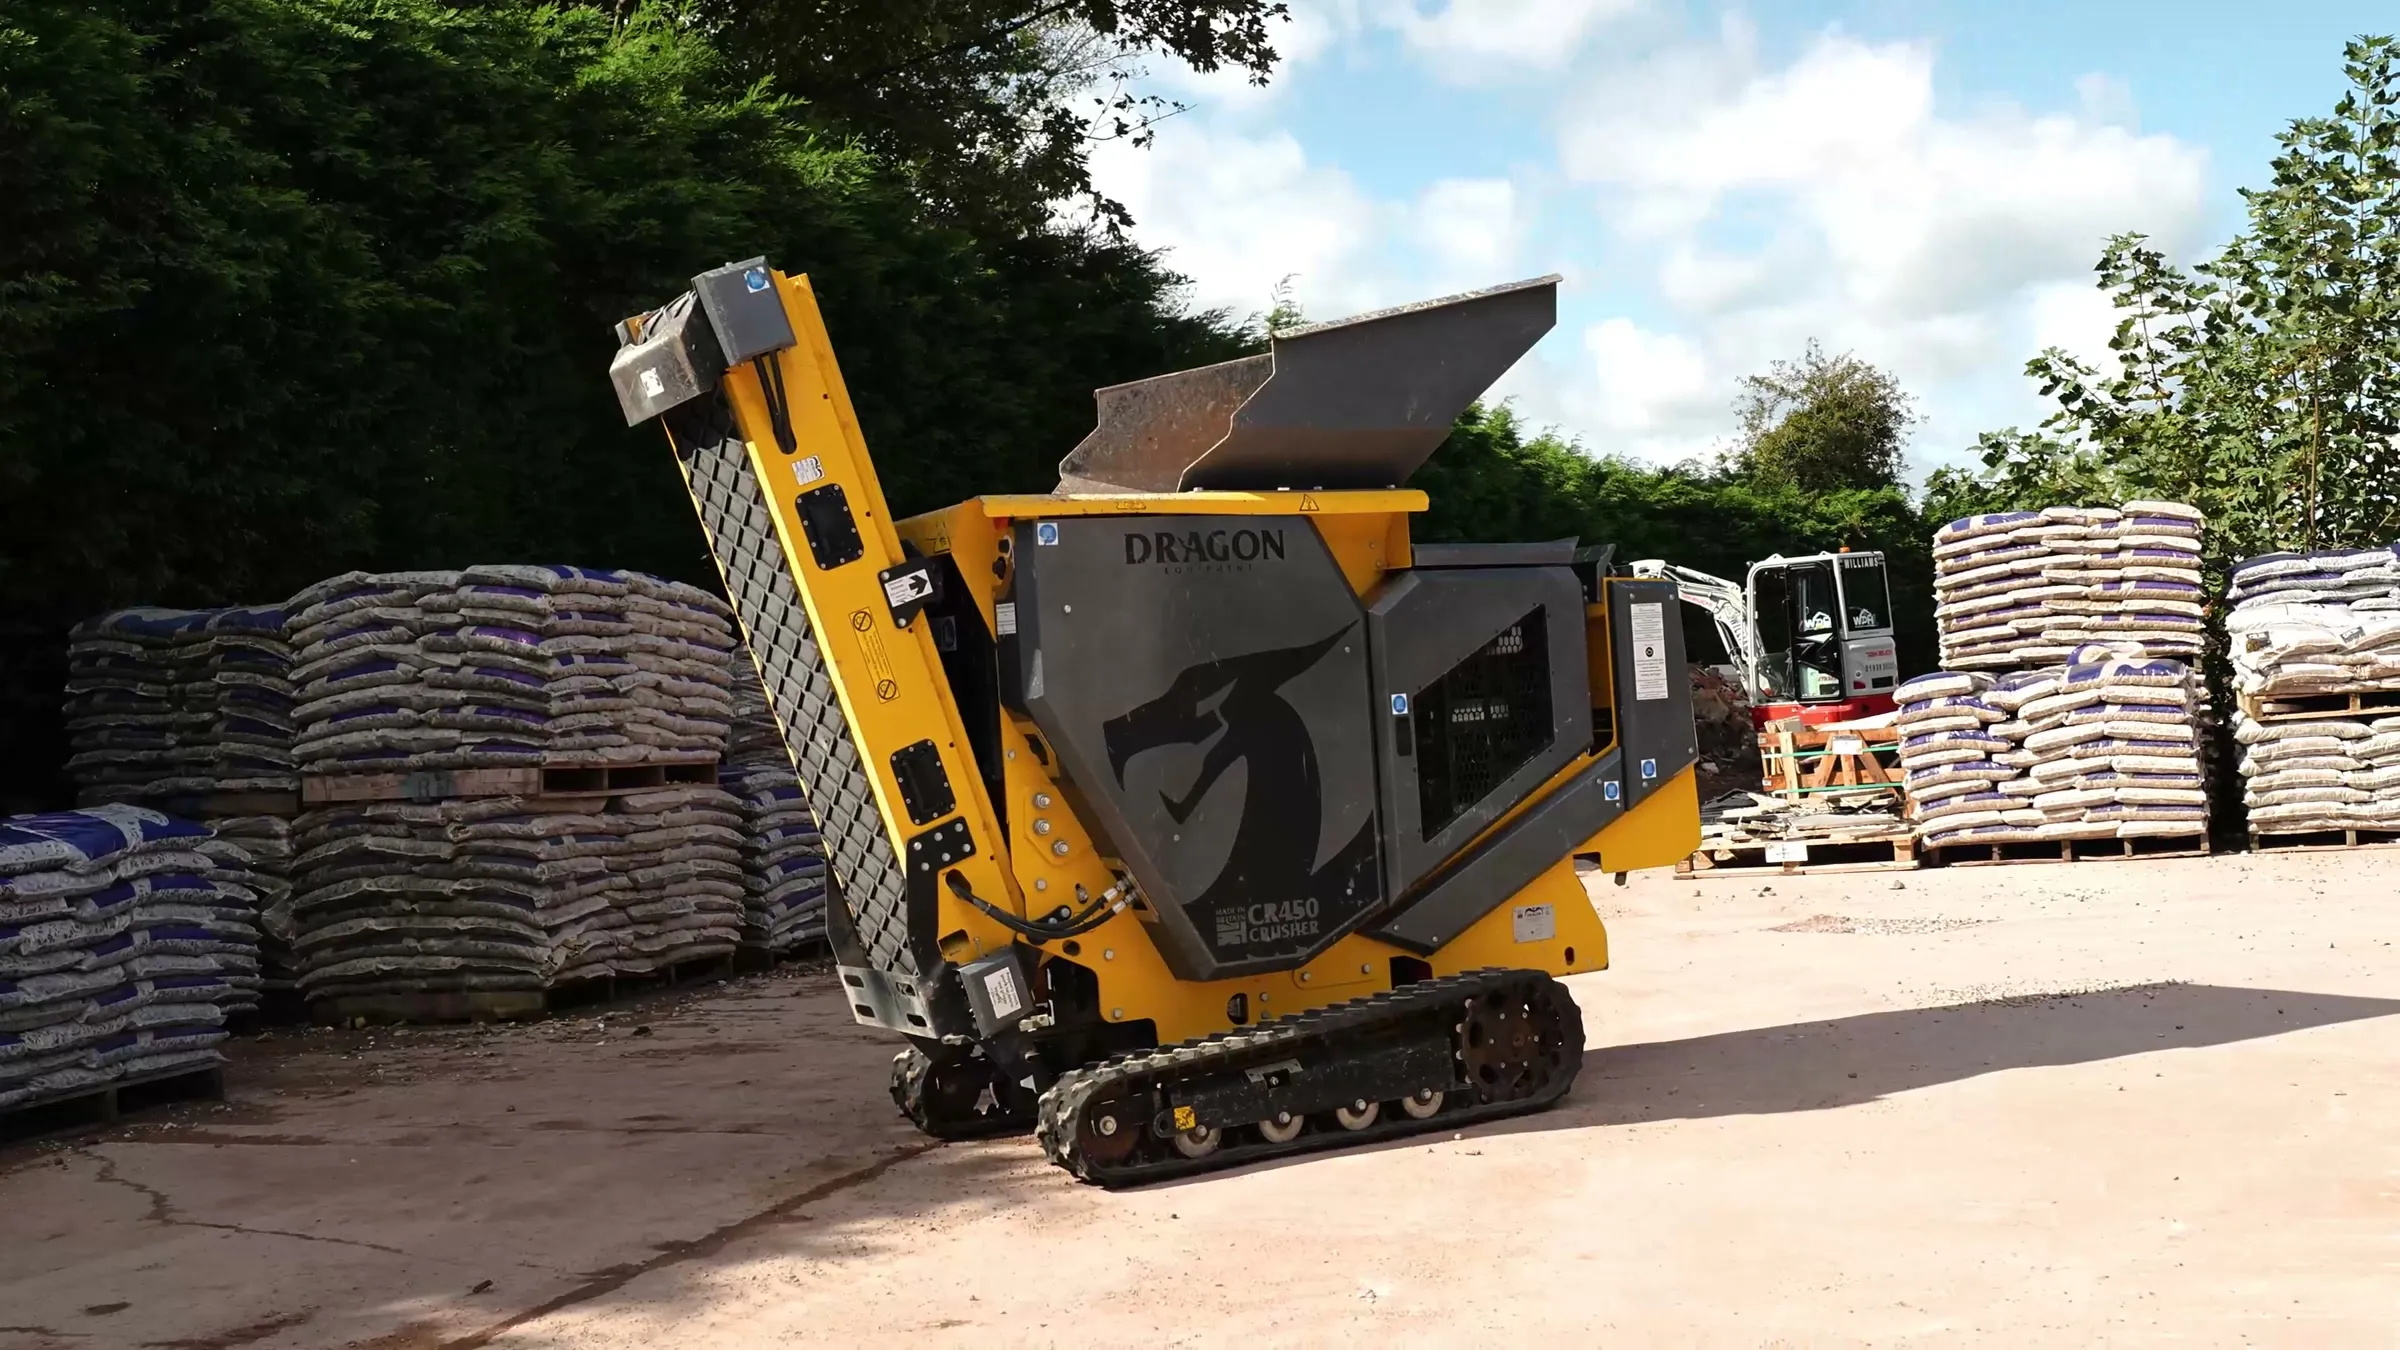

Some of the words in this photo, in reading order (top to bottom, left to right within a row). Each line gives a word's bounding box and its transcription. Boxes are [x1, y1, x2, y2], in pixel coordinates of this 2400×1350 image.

[1124, 529, 1284, 564] DRAGON
[1843, 556, 1879, 569] WILLIAMS
[1247, 897, 1319, 925] CR450
[1249, 920, 1319, 942] CRUSHER
